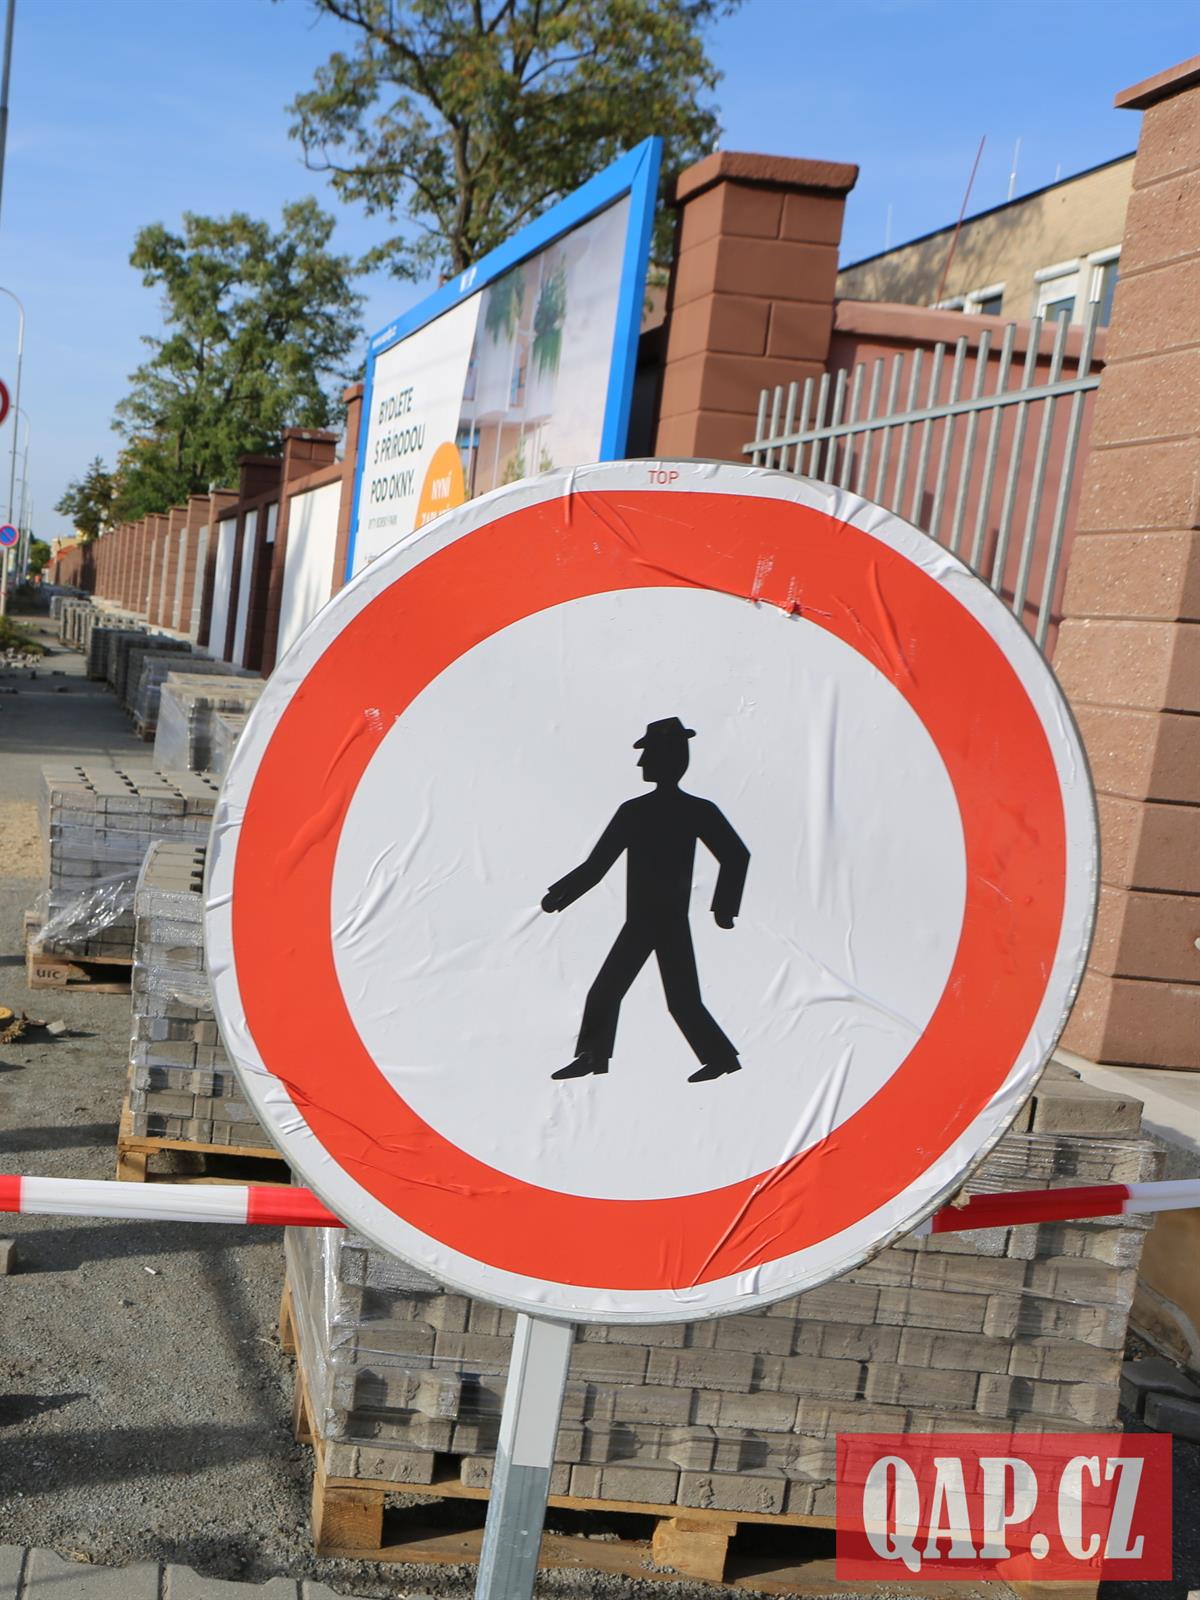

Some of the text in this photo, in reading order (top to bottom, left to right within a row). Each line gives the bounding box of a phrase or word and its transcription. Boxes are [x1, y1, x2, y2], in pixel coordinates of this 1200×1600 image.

[378, 386, 414, 425] BYDLETE
[374, 440, 380, 464] S
[370, 469, 415, 504] POD OKNY.
[648, 470, 679, 485] TOP
